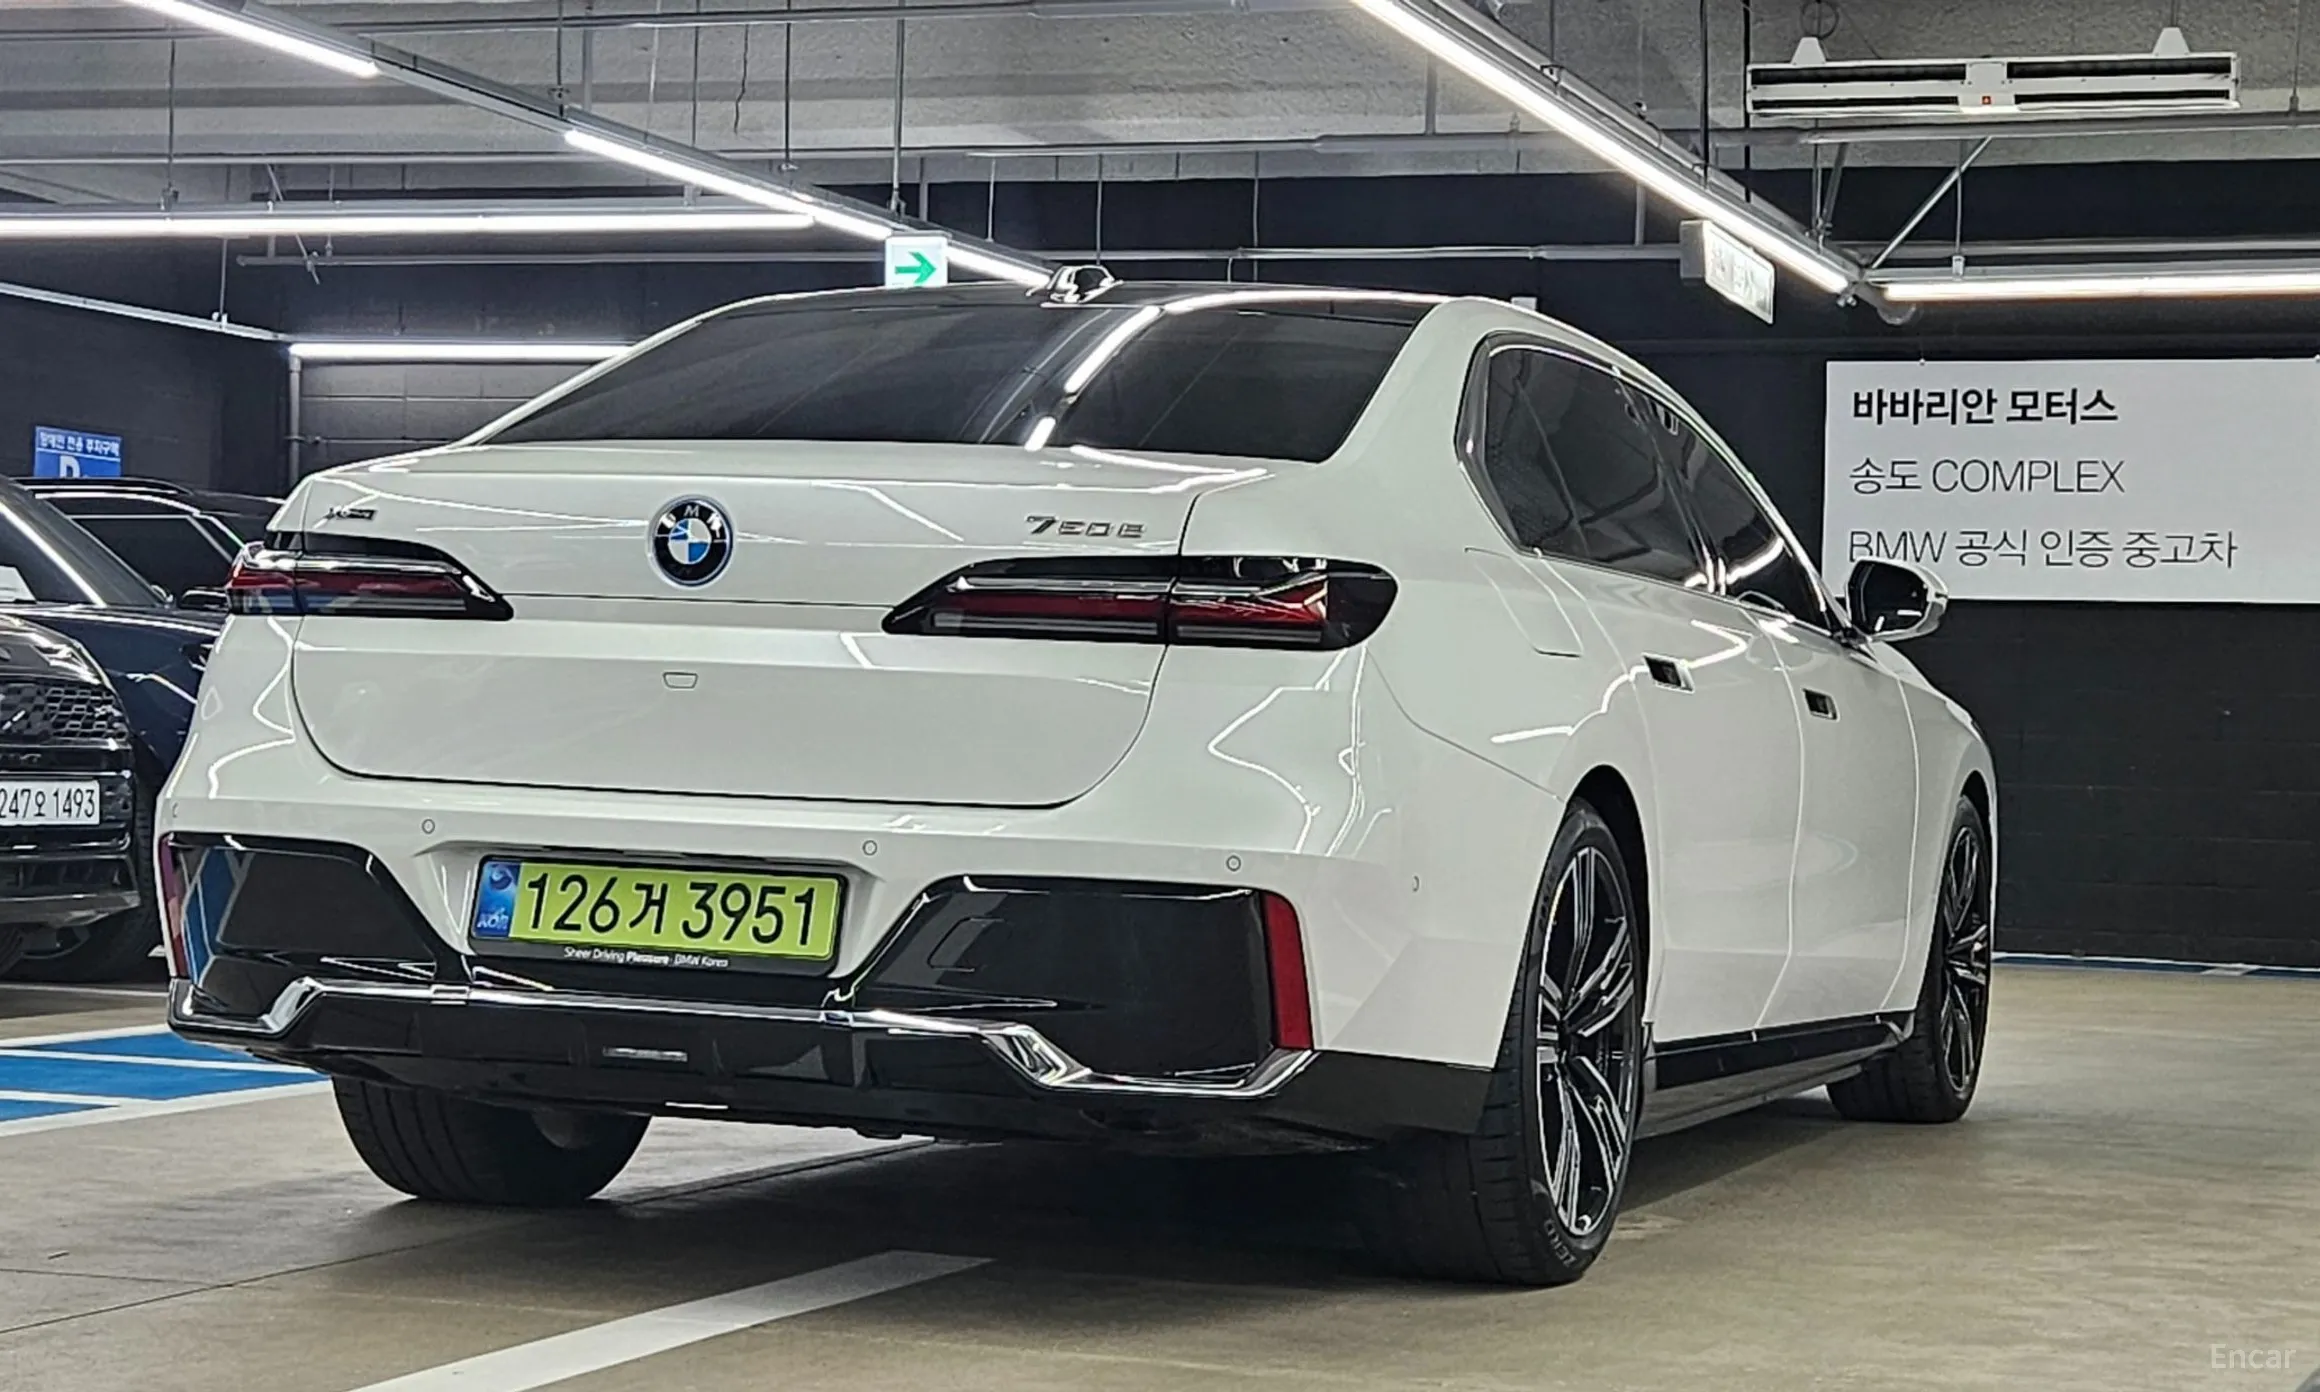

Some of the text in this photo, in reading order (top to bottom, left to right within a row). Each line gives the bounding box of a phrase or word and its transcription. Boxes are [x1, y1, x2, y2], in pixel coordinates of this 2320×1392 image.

[1853, 388, 2119, 425] 바바리안 모터스
[1849, 457, 2126, 495] 송도 COMPLEX
[1849, 529, 2238, 569] BMW 공식 인증 중고차
[53, 788, 95, 818] 1493
[527, 872, 815, 947] 126거 3951
[593, 948, 625, 964] Driving
